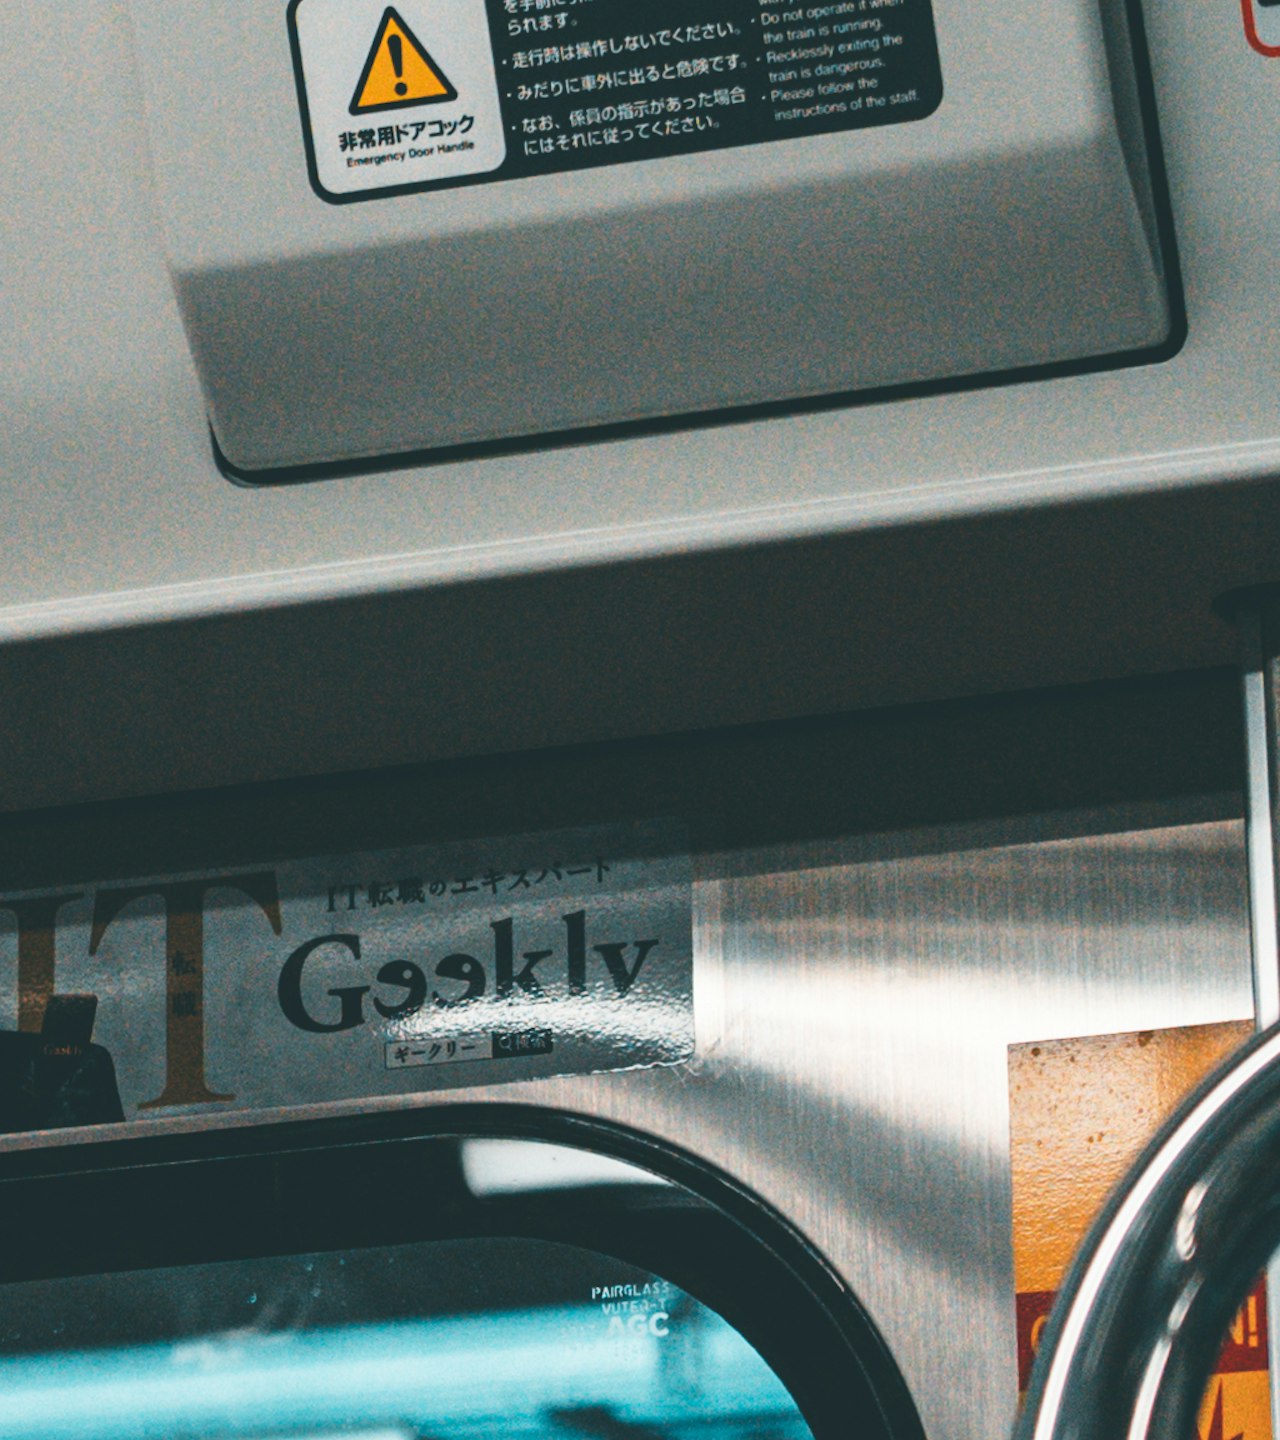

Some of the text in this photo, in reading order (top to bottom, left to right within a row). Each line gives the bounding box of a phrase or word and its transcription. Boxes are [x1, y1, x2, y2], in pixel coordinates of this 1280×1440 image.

[760, 12, 779, 26] Do
[783, 9, 803, 22] not
[806, 2, 855, 21] operate
[763, 17, 883, 45] the train is running.
[766, 34, 903, 64] Recklessly exiting the
[768, 57, 886, 83] train is dangerous.
[770, 76, 878, 103] Please follow the
[774, 89, 920, 122] instructions of the staff.
[339, 115, 475, 152] 非常用ドアコック
[346, 140, 475, 167] Emergency Door Handle
[326, 858, 612, 913] IT転職のエキスパート
[393, 1041, 476, 1065] ギークリー
[591, 1280, 670, 1300] PAIRGLASS
[606, 1311, 670, 1337] AGC
